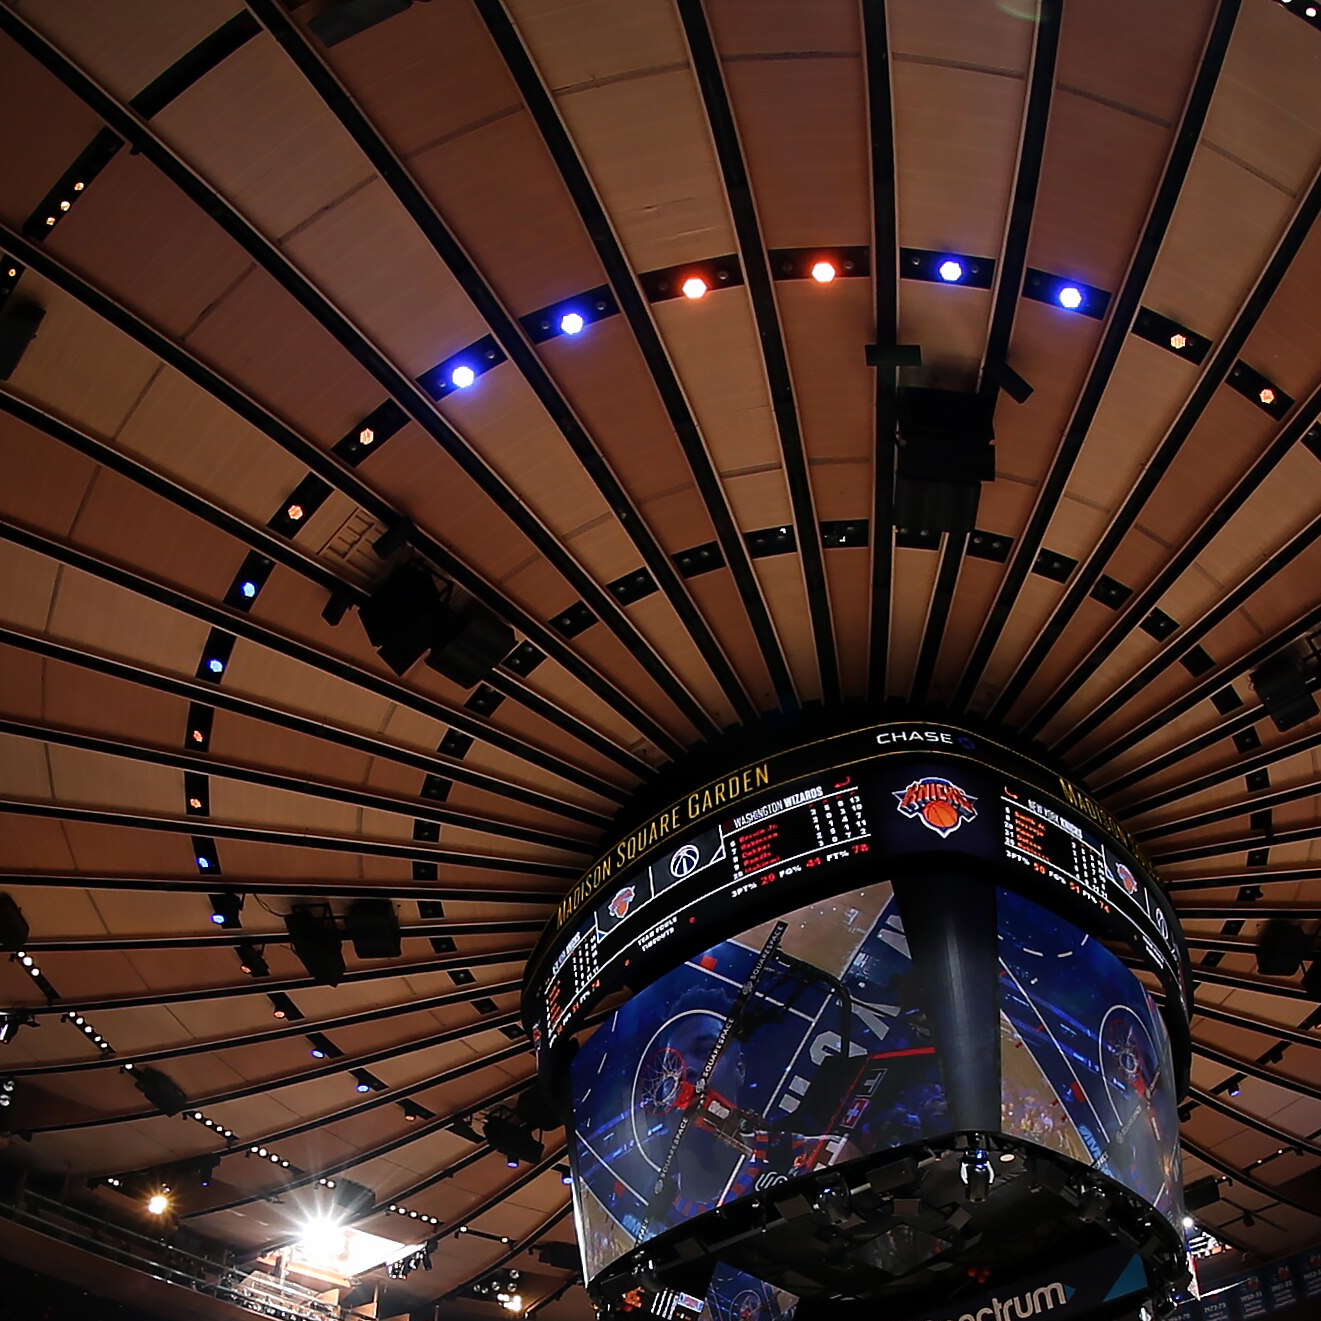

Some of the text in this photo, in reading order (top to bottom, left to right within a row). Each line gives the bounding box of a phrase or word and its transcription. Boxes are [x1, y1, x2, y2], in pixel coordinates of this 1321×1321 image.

[876, 731, 954, 745] CHASE
[733, 786, 824, 829] WASHINGTON WIZARDS
[557, 764, 769, 929] MADISON SQUARE GARDEN
